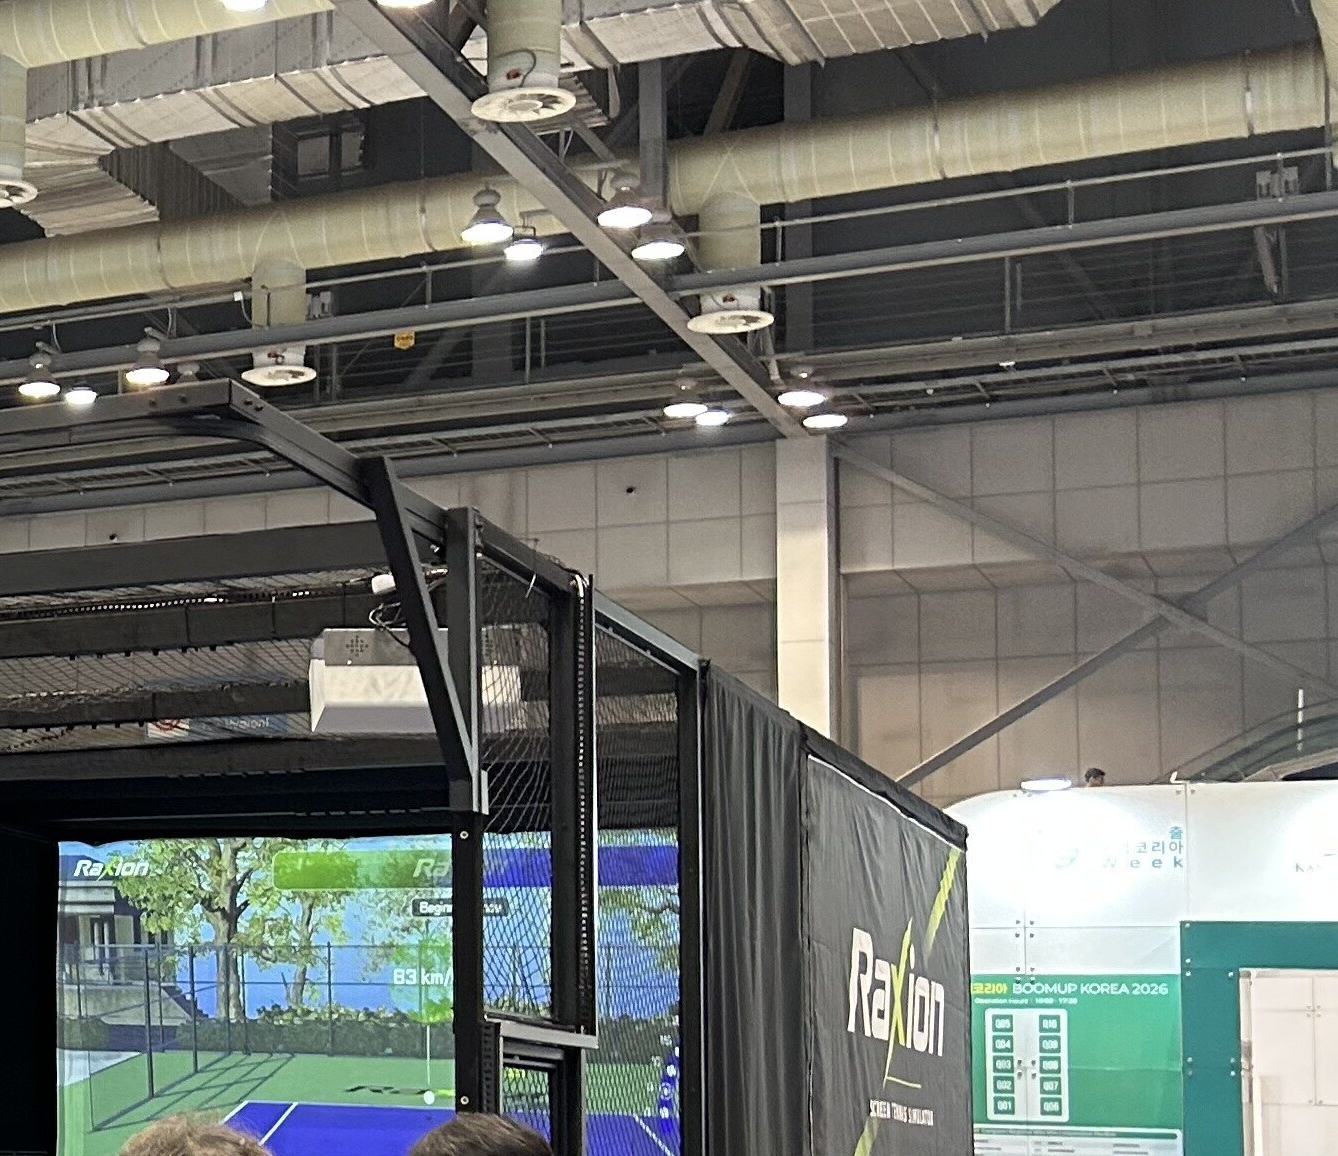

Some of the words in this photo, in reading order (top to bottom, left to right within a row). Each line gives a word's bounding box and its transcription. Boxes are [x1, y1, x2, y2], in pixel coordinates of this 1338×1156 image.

[73, 855, 150, 881] Raxion
[393, 968, 417, 985] 83
[420, 967, 453, 986] km/
[1013, 982, 1077, 995] BOOMUP
[1080, 982, 1129, 995] KOREA
[1132, 982, 1169, 995] 2026
[847, 916, 945, 1088] Raxion
